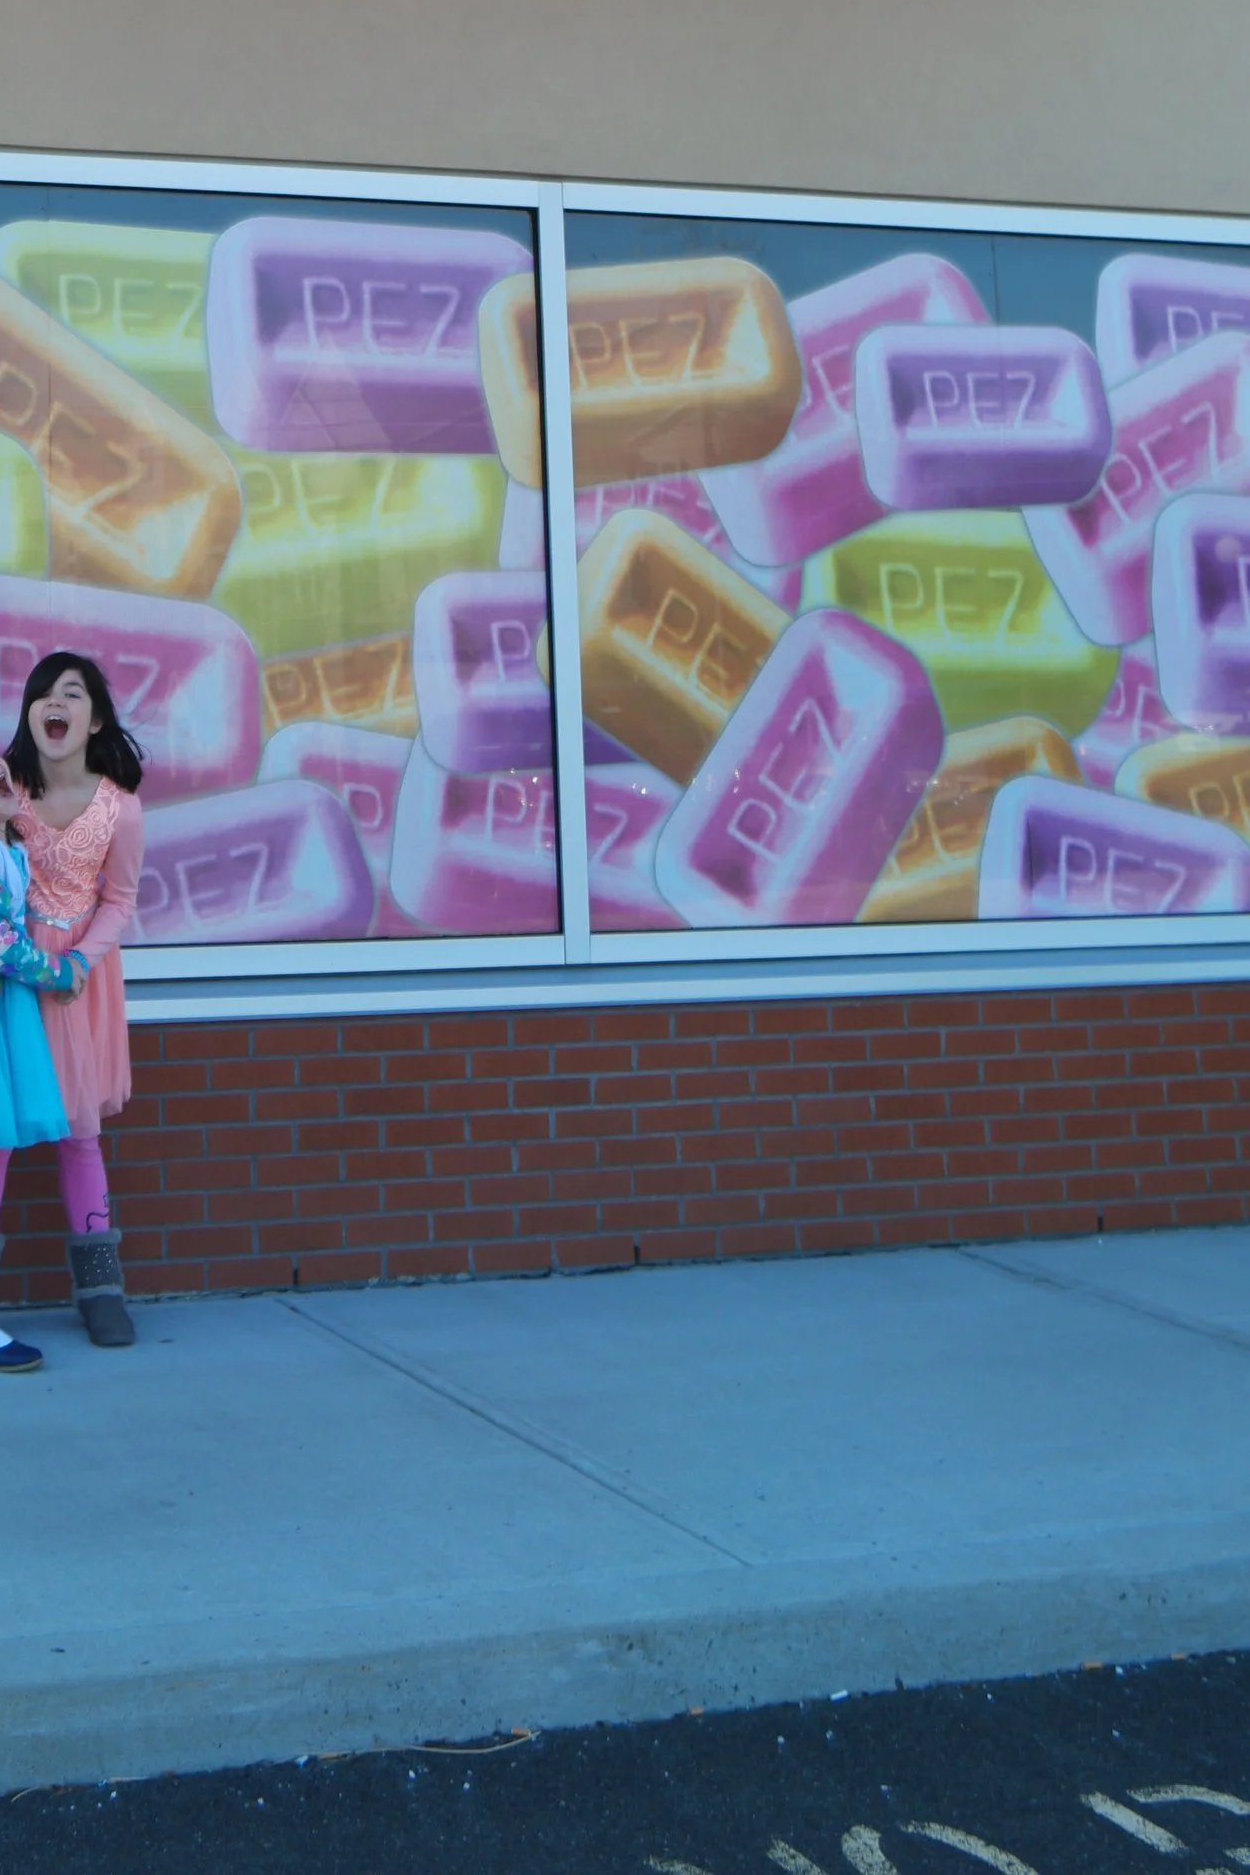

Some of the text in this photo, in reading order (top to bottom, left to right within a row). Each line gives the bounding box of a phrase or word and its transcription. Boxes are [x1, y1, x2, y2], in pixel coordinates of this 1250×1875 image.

[303, 275, 472, 360] PEZ
[570, 312, 735, 391] PEZ
[922, 371, 1050, 427] PEZ
[878, 561, 1038, 637] PEZ
[726, 697, 847, 863] PEZ
